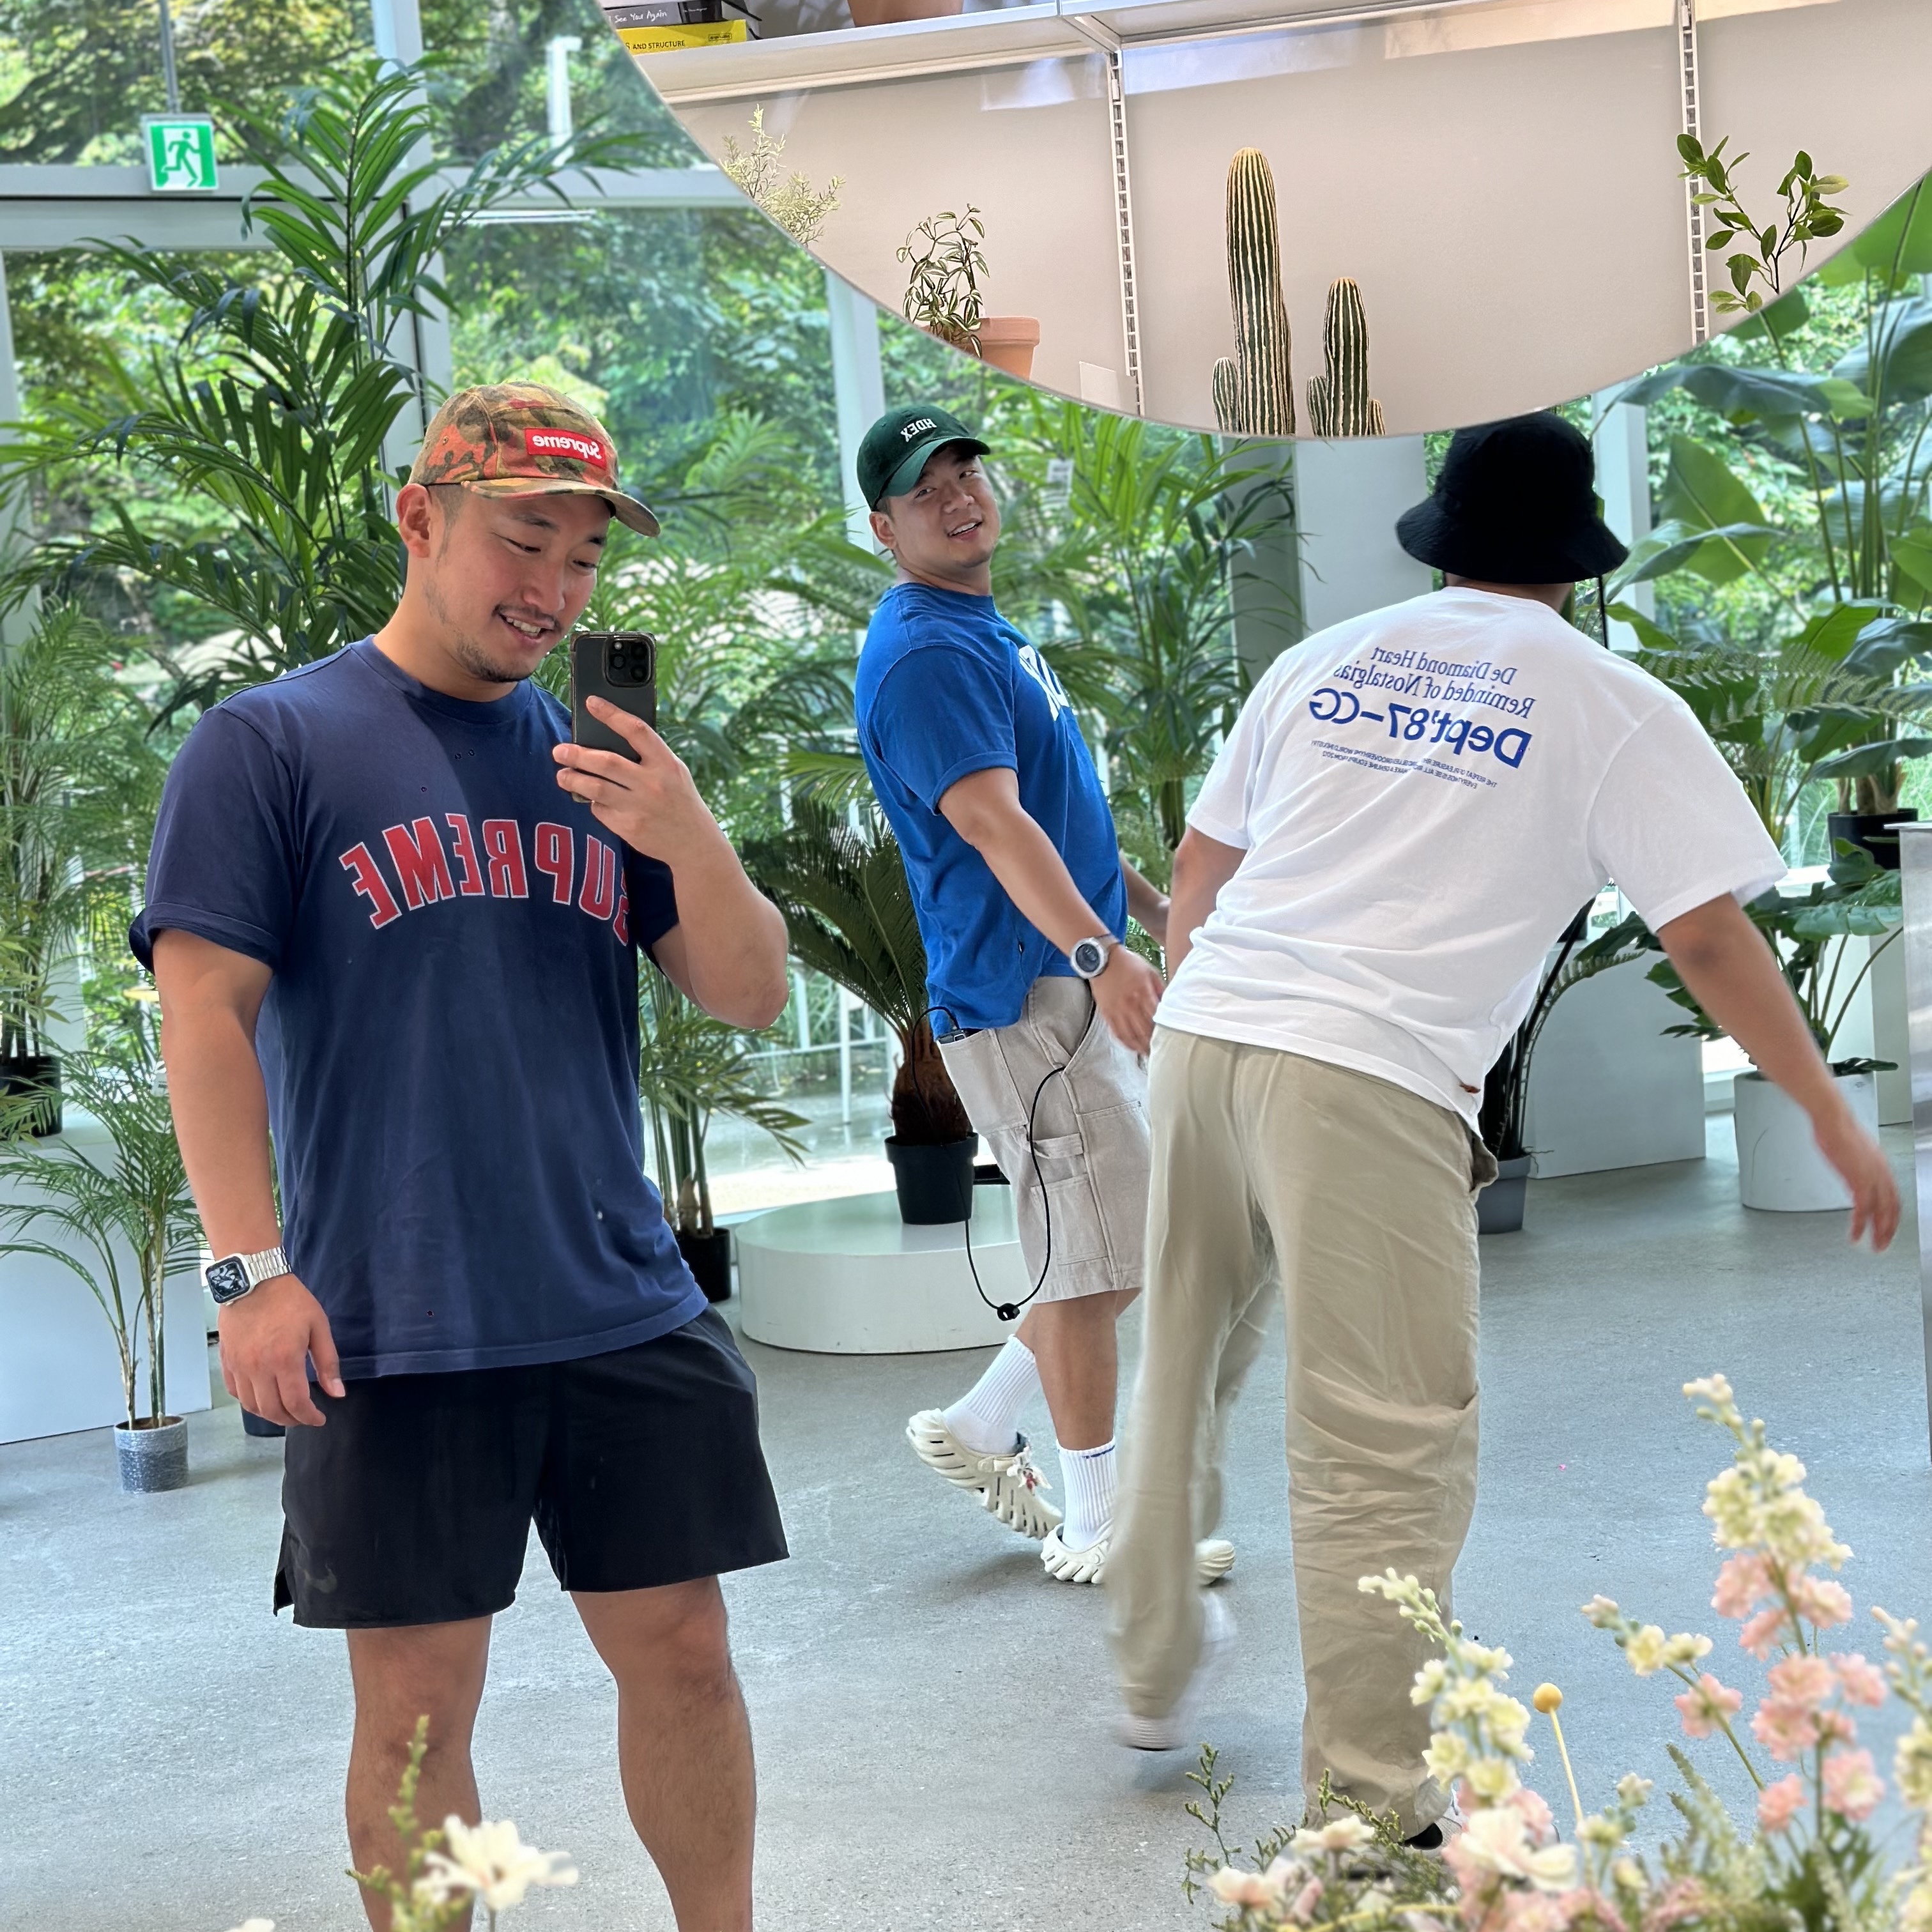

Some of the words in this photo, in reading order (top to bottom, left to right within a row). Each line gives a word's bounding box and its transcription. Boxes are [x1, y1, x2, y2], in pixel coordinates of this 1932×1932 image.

[615, 15, 627, 23] See
[630, 13, 643, 21] You
[647, 10, 668, 22] Again
[648, 40, 686, 49] STRUCTURE
